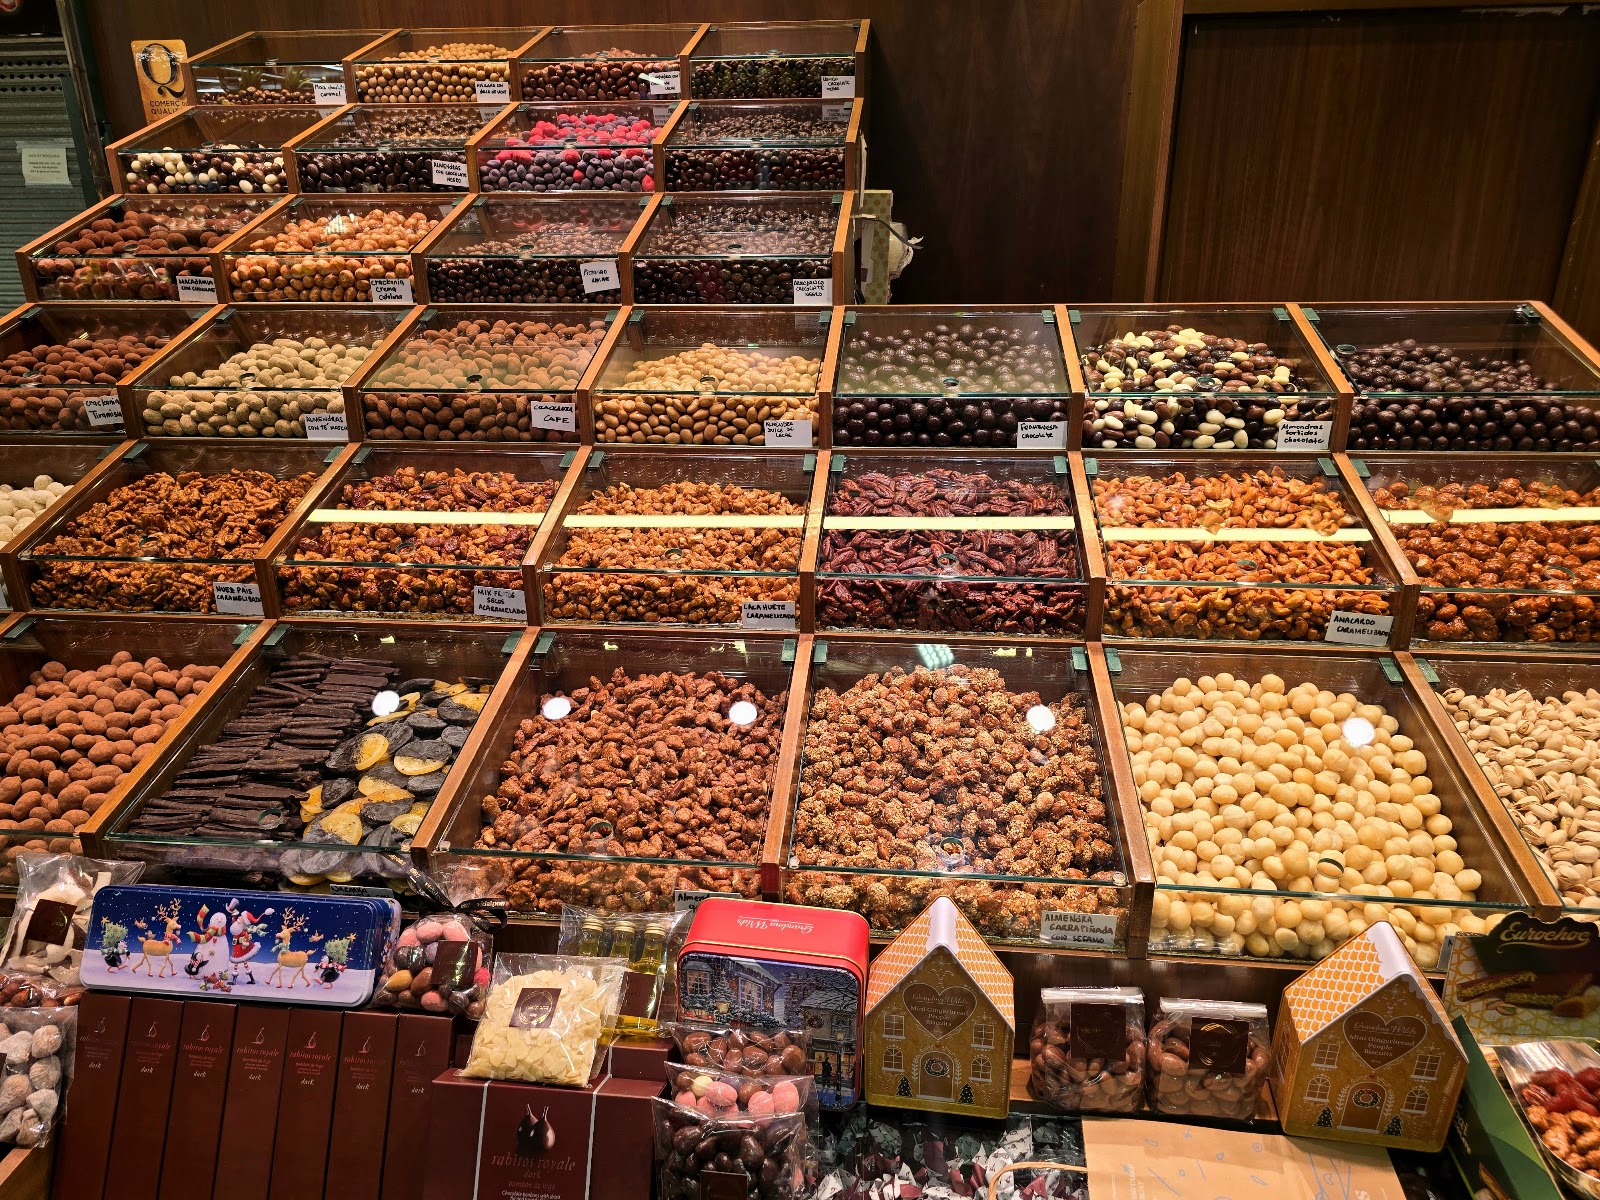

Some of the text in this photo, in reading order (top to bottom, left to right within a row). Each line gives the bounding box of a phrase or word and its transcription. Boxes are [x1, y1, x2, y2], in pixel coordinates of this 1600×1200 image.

[141, 43, 185, 98] Q
[487, 597, 505, 605] SECOS
[1333, 615, 1375, 626] ANACARDO
[1499, 921, 1591, 942] Eurochoc
[927, 1007, 969, 1016] Gingerbread
[1368, 1036, 1415, 1047] Gingerbread
[1367, 1043, 1393, 1051] People
[1364, 1049, 1393, 1057] Biscuits
[193, 1070, 207, 1078] dark
[248, 1073, 262, 1081] dark
[491, 1152, 576, 1173] rabitos royale
